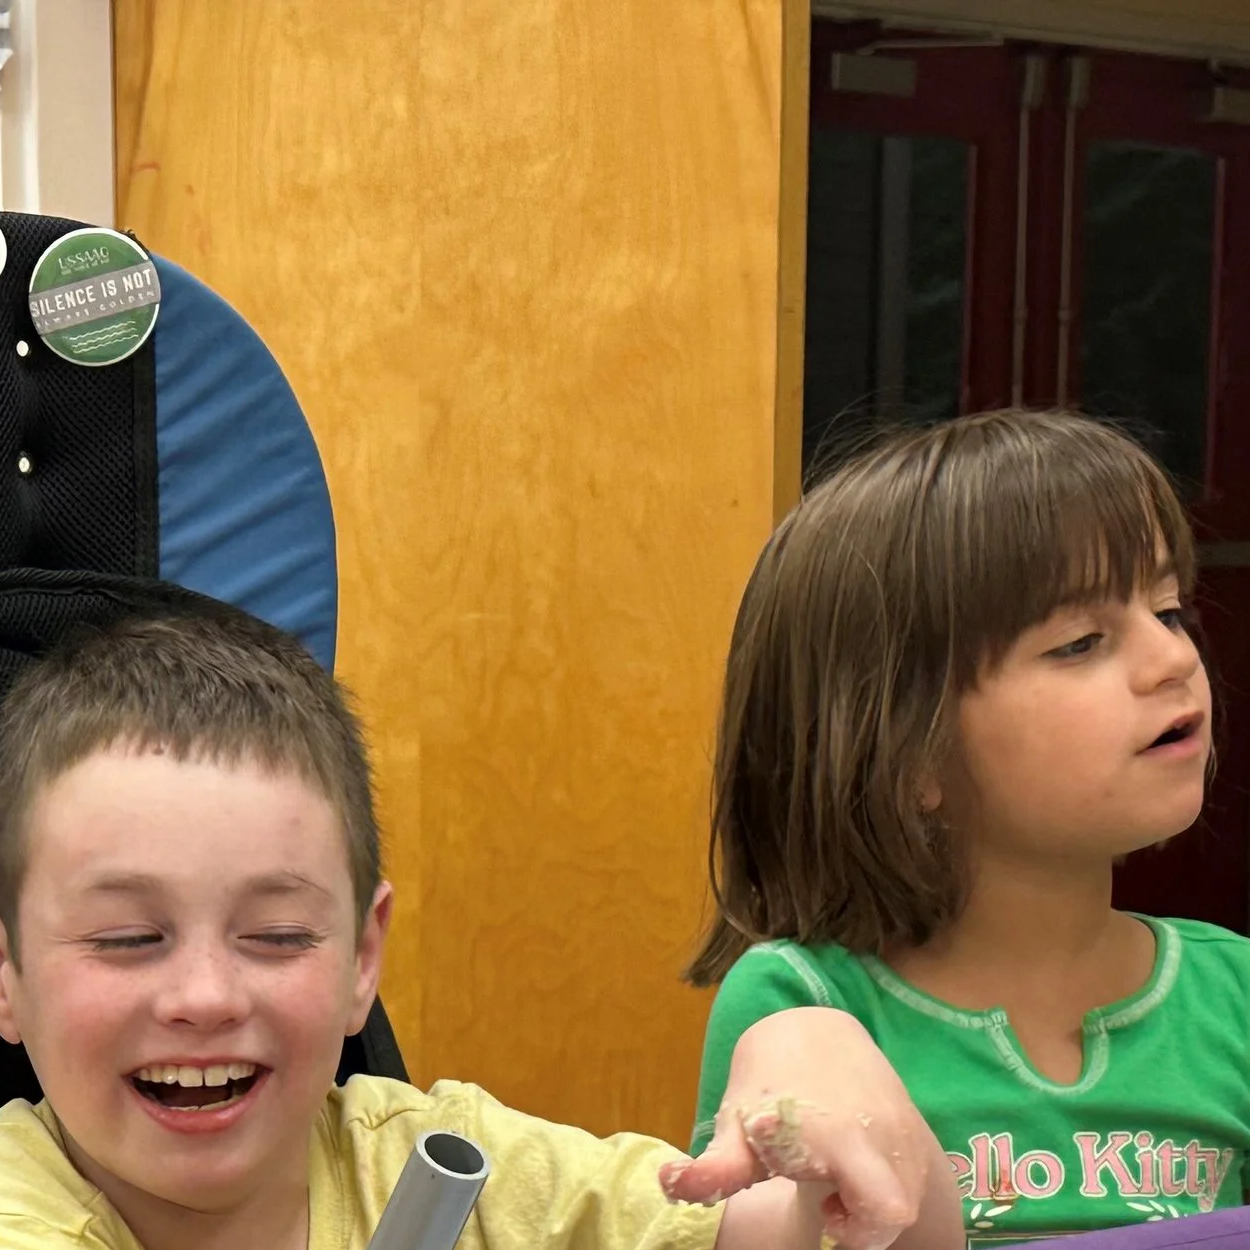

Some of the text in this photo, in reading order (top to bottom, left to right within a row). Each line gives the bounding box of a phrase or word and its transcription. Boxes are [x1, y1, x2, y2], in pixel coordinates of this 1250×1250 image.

[30, 268, 152, 318] SILENCE IS NOT
[946, 1131, 1234, 1213] ello Kitty
